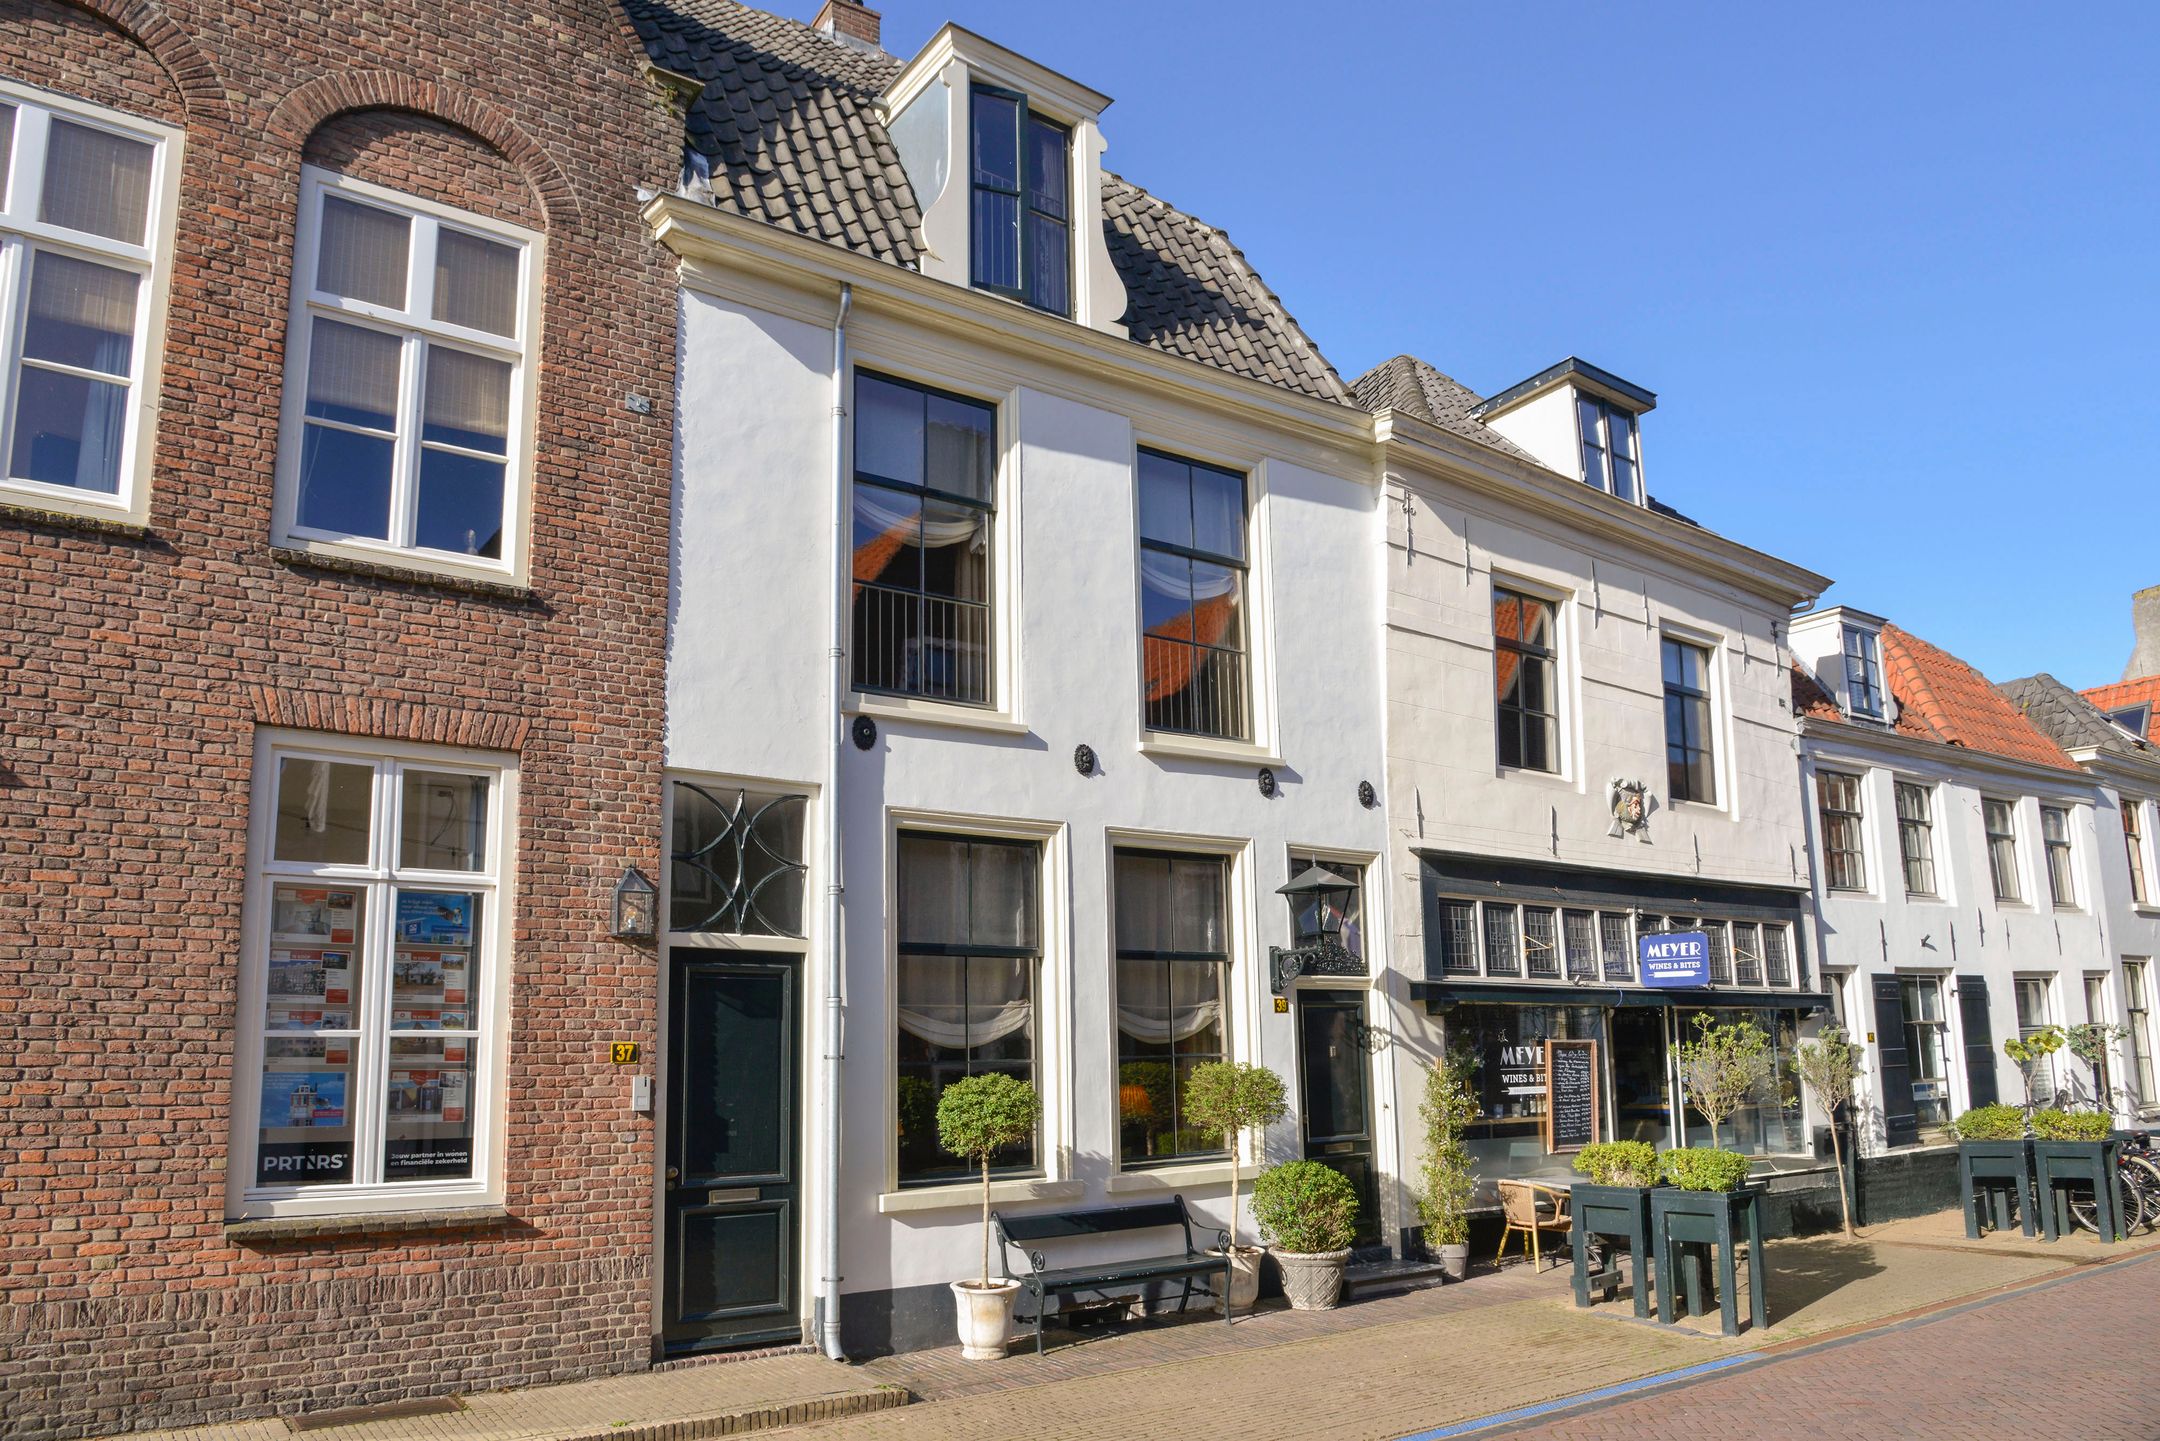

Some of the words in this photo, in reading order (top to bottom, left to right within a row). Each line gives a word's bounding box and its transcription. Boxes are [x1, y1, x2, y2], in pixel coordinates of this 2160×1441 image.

[1647, 942, 1701, 958] MEYER
[1648, 962, 1672, 970] WINES
[1680, 961, 1701, 969] BITES
[1276, 999, 1287, 1012] 39
[616, 1044, 634, 1062] 37
[1500, 1046, 1545, 1065] MEYE
[1502, 1074, 1528, 1083] WINES
[1529, 1074, 1535, 1083] &
[1536, 1073, 1547, 1082] BIT
[410, 1151, 436, 1160] partner
